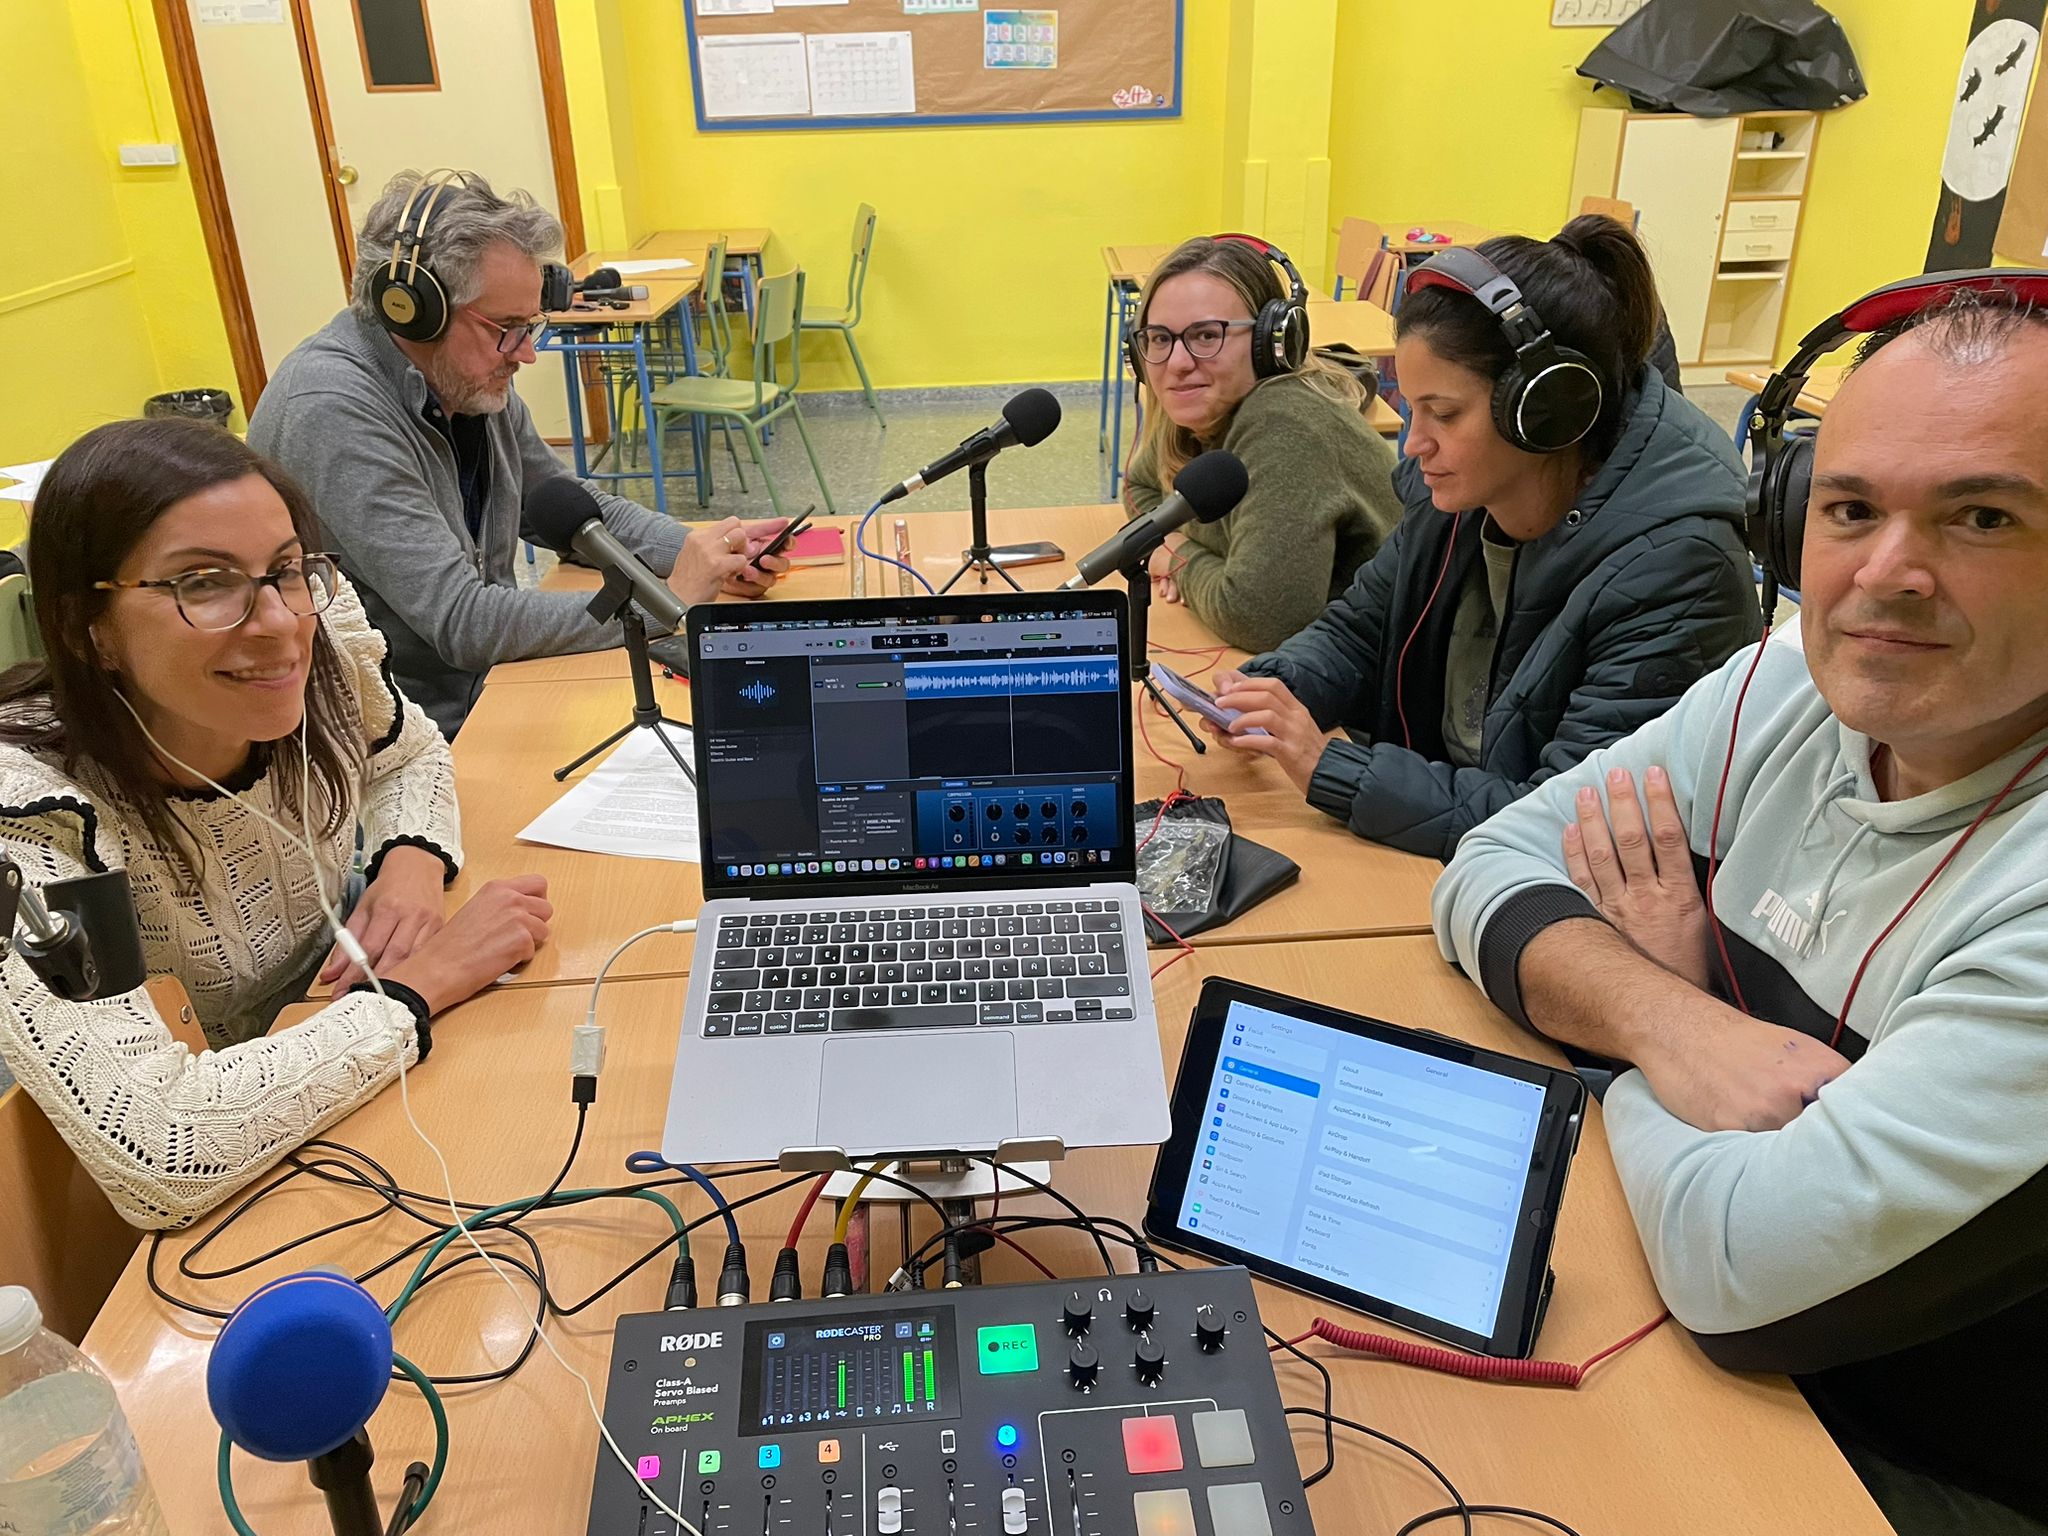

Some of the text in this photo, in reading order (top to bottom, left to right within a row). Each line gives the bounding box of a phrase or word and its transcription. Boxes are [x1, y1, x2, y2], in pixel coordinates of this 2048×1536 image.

[767, 953, 774, 961] Q
[882, 948, 887, 956] T
[938, 946, 944, 954] U
[888, 969, 894, 977] G
[974, 965, 980, 973] K
[1031, 962, 1038, 970] Ñ
[1088, 961, 1095, 969] Ç
[843, 993, 849, 1001] C
[959, 988, 967, 996] M
[1272, 1024, 1293, 1034] Settings
[1246, 1042, 1263, 1050] Screen
[1342, 1066, 1359, 1075] About
[1426, 1066, 1449, 1078] General
[1236, 1080, 1254, 1089] Control
[1339, 1079, 1384, 1097] Software Update
[1232, 1093, 1250, 1104] Display
[1257, 1101, 1284, 1113] Brightness
[1333, 1105, 1361, 1118] AppleCare
[1367, 1114, 1392, 1128] Warranty
[1245, 1113, 1263, 1123] Screen
[1280, 1124, 1298, 1135] Library
[1262, 1134, 1285, 1145] Gestures
[1328, 1130, 1348, 1142] AirDrop
[1324, 1145, 1342, 1157] AirPlay
[1349, 1151, 1371, 1164] Handoff
[1229, 1170, 1247, 1180] Search
[1331, 1174, 1352, 1186] Storage
[1314, 1185, 1380, 1211] Background App Refresh
[1308, 1210, 1321, 1219] Date
[1302, 1240, 1317, 1250] Fonts
[1298, 1256, 1324, 1269] Language
[1331, 1267, 1349, 1278] Region
[863, 1334, 882, 1342] PRO
[1141, 1330, 1148, 1340] 3
[660, 1332, 723, 1352] RØDE
[1003, 1339, 1029, 1352] REC
[656, 1377, 692, 1389] Class-A
[1149, 1381, 1157, 1389] 4
[655, 1384, 719, 1399] Servo Biased
[1083, 1386, 1091, 1395] 2
[653, 1398, 687, 1408] Preamps
[906, 1403, 914, 1413] L
[927, 1402, 935, 1412] R
[652, 1412, 715, 1425] APHEX
[651, 1424, 689, 1435] On board
[765, 1449, 773, 1460] 3
[824, 1445, 832, 1455] 4
[644, 1460, 652, 1470] 1
[705, 1454, 713, 1465] 2
